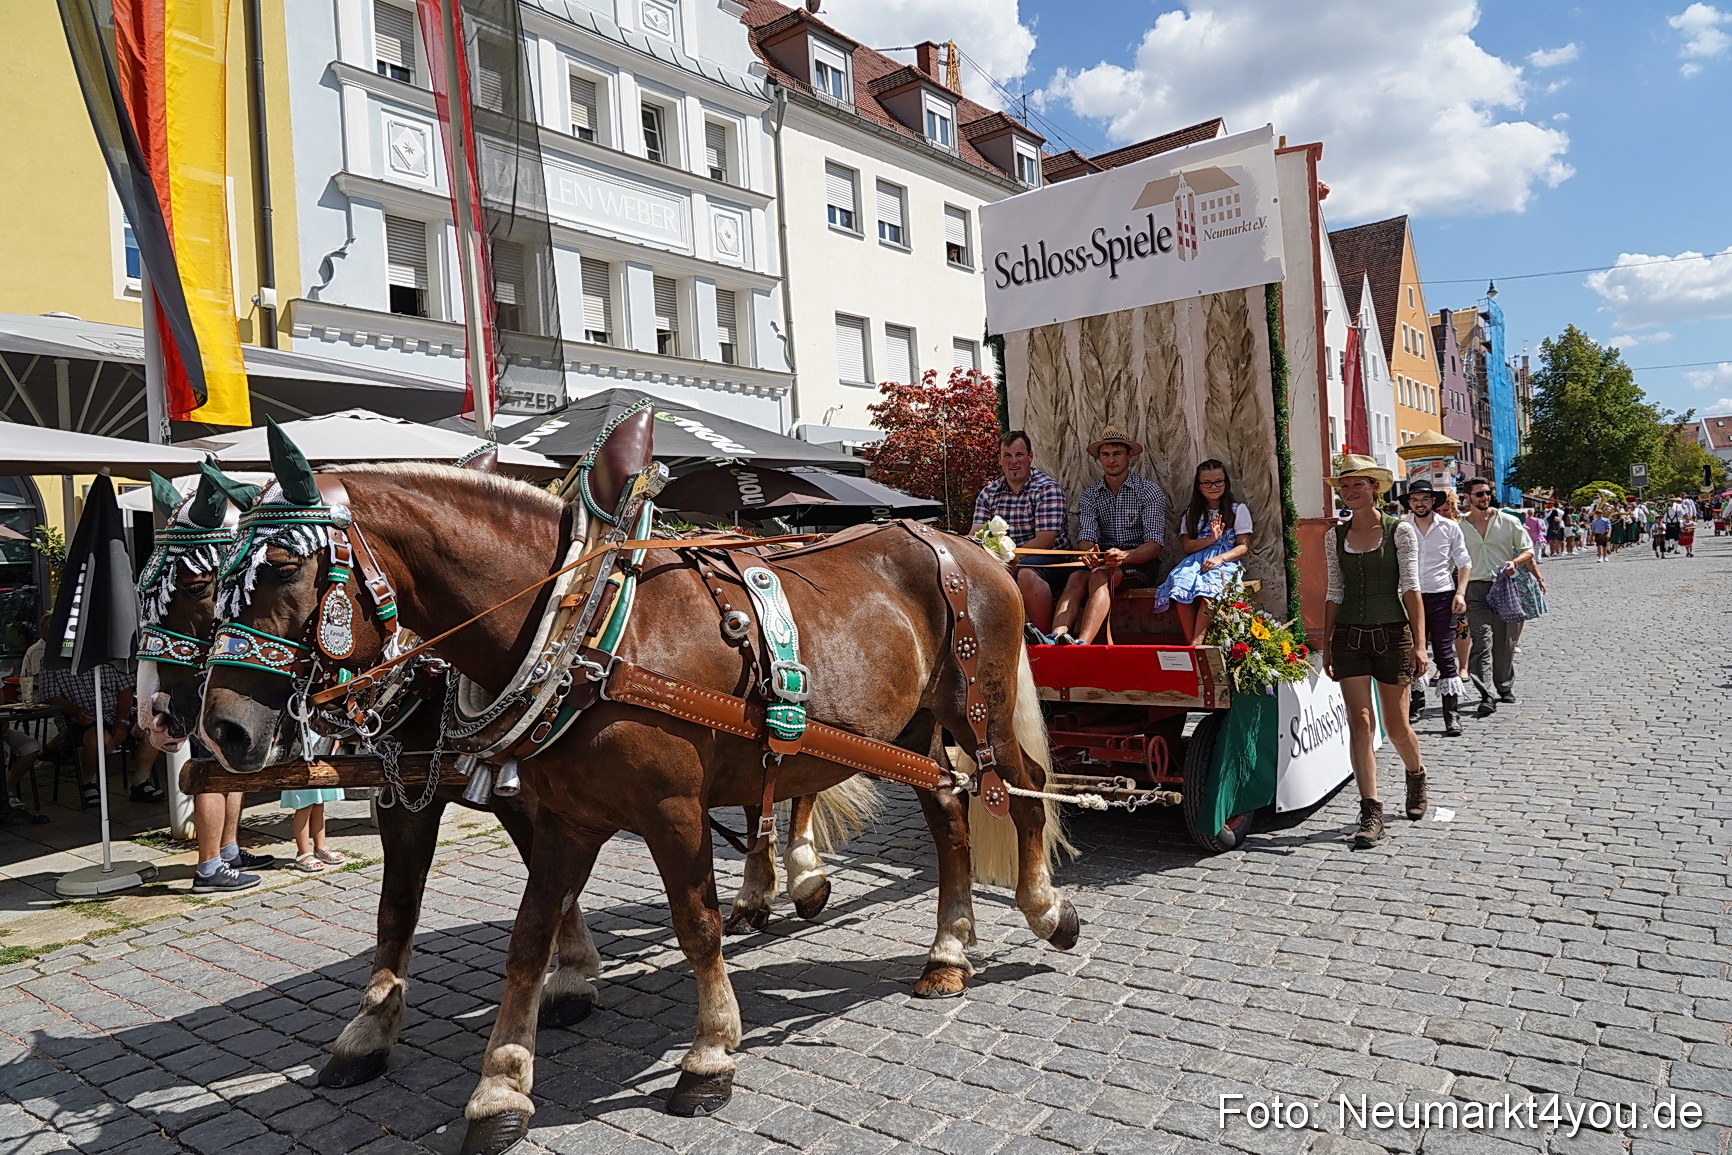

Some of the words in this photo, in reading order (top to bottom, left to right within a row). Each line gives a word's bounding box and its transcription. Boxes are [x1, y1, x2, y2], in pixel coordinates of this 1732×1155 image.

[596, 187, 678, 233] WEBER
[1202, 219, 1252, 242] Neumarkt
[1252, 215, 1268, 231] e.V.
[994, 212, 1173, 290] Schloss-Spiele
[736, 471, 766, 506] now
[1289, 692, 1349, 759] Schloss-Spi
